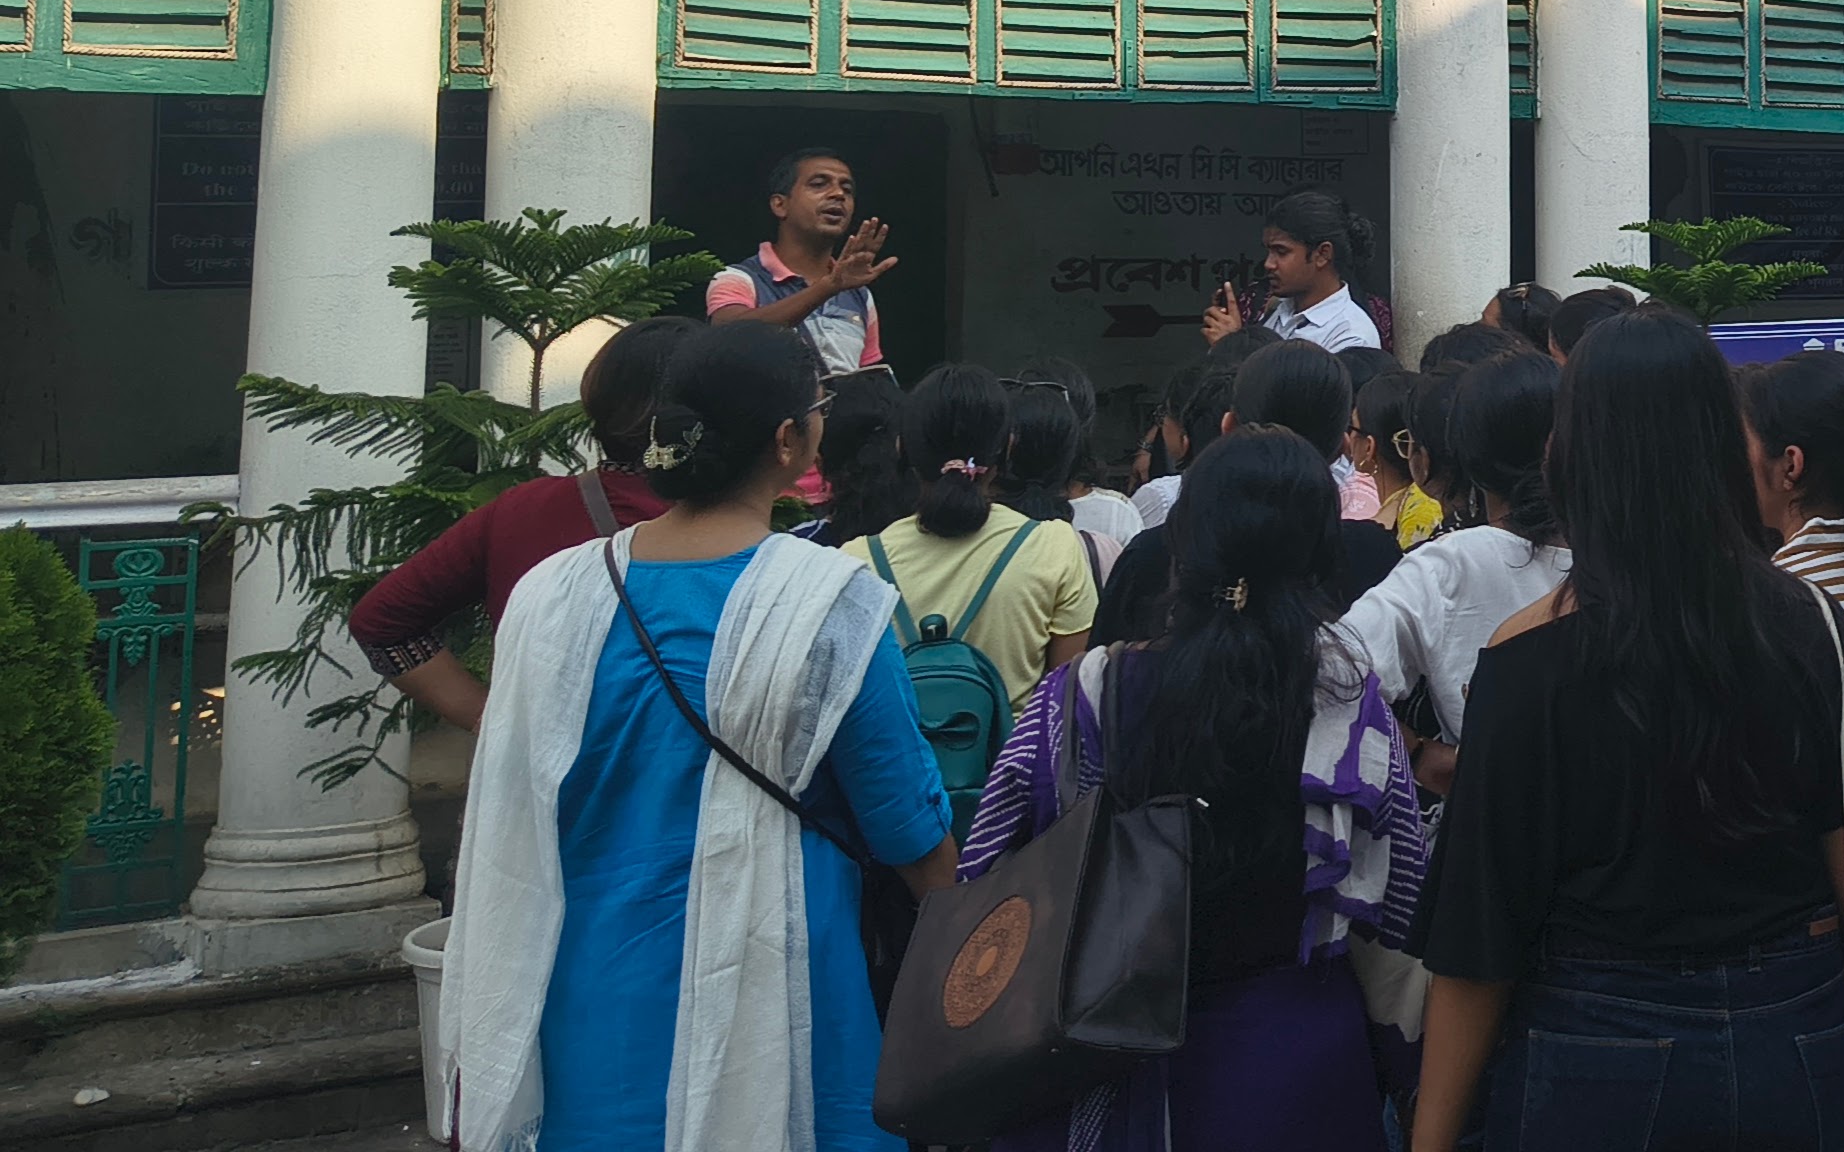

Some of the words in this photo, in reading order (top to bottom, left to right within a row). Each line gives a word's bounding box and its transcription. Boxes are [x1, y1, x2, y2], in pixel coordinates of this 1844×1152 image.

[1039, 143, 1119, 177] আপনি
[1111, 189, 1228, 217] আওতায়
[1050, 253, 1208, 293] প্রবেশ
